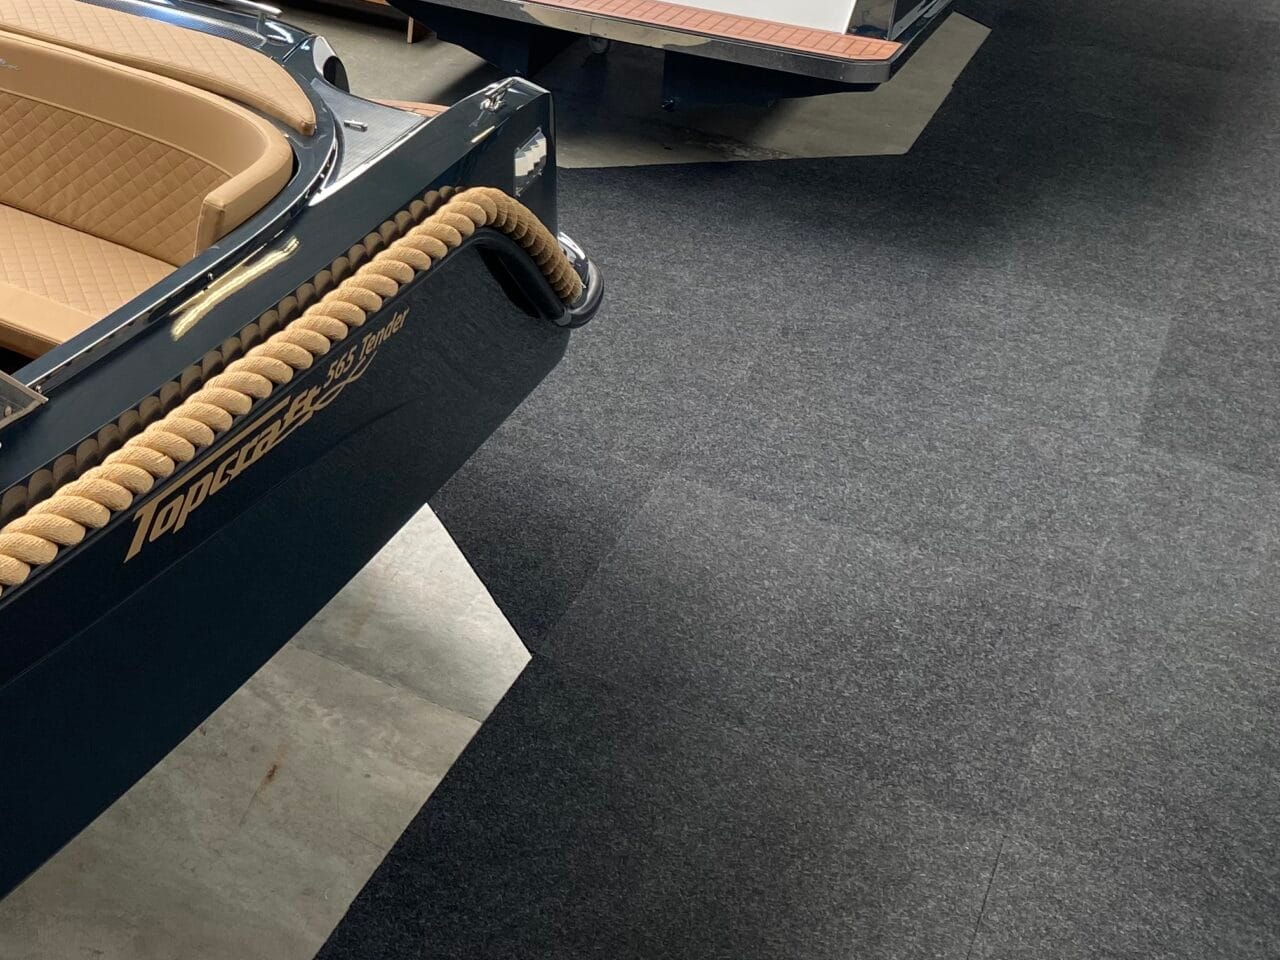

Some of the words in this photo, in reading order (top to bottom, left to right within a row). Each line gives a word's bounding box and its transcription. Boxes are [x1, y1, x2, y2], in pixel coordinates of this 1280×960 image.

[123, 385, 321, 564] Topcraft
[324, 346, 359, 388] 565
[358, 307, 410, 360] Tender
